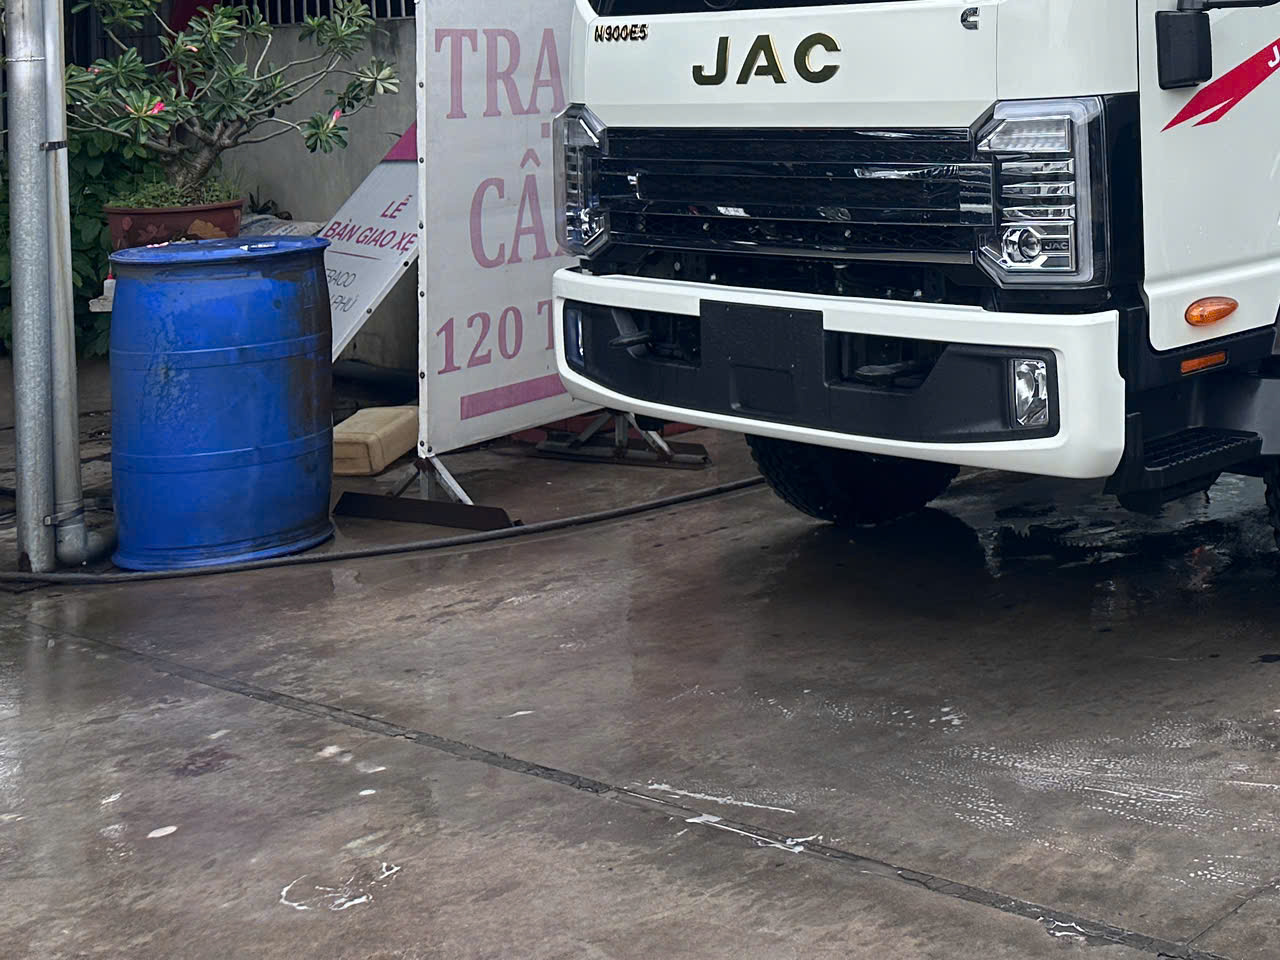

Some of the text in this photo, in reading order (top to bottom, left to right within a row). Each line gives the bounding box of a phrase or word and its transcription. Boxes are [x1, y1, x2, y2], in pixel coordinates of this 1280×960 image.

[435, 28, 567, 139] TRẠ
[692, 32, 841, 85] JAC
[323, 219, 361, 241] BÀN
[356, 226, 397, 248] GIAO
[469, 148, 566, 269] CÂ
[1045, 241, 1069, 250] JAC
[436, 306, 523, 375] 120
